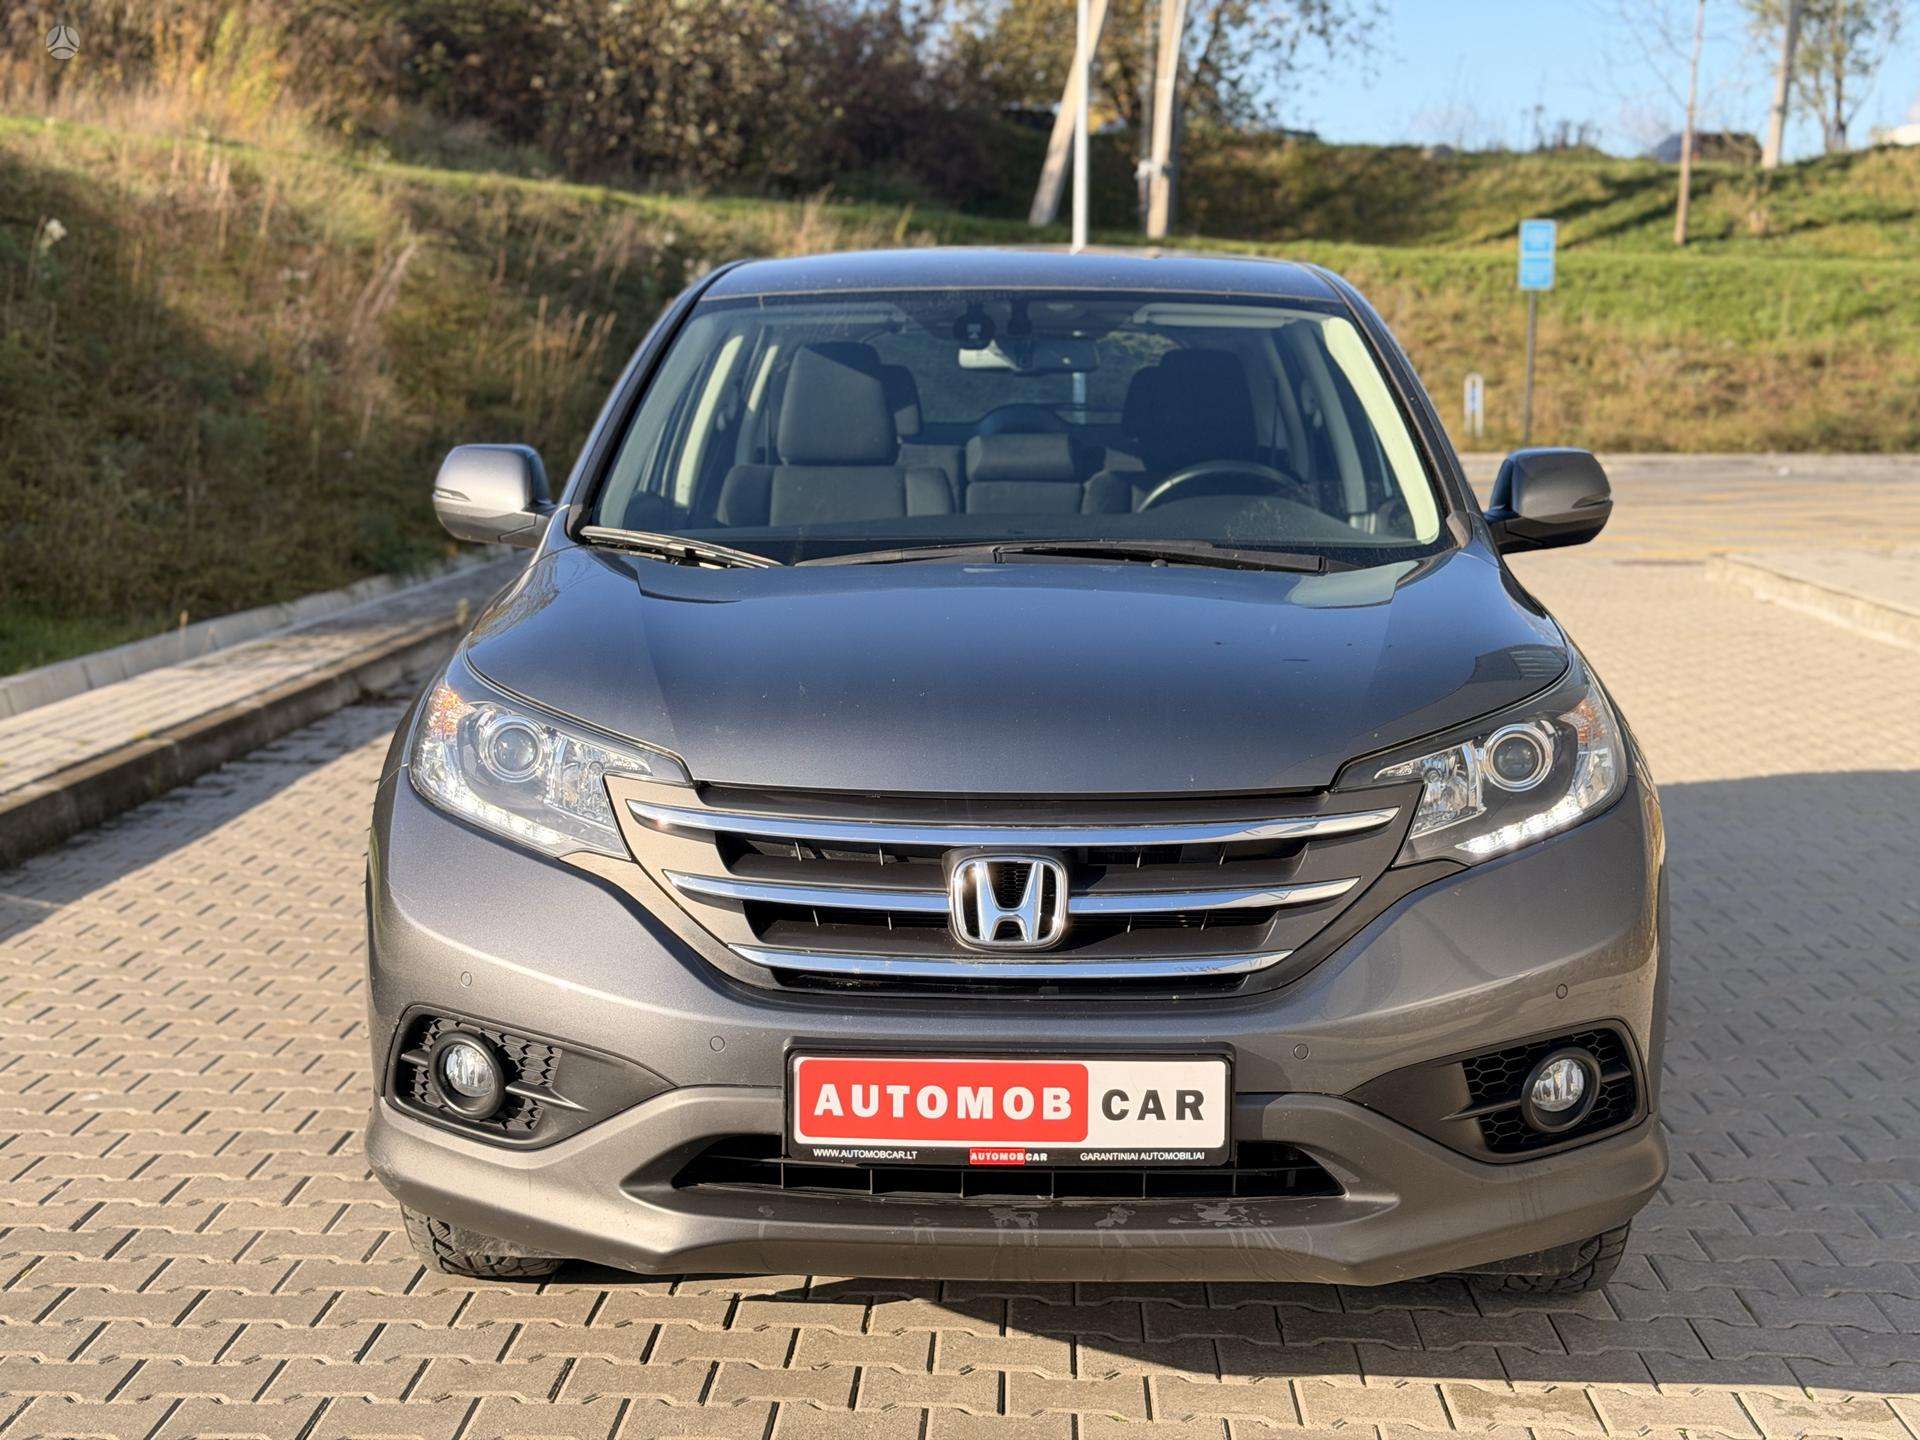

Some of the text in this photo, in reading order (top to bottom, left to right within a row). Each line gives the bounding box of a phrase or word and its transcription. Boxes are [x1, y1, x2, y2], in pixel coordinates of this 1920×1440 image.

[813, 1083, 1205, 1122] AUTOMOB CAR
[812, 1148, 918, 1160] WWW.AUTOMOBCAR.LT
[1079, 1151, 1205, 1162] GARANTINIAI AUTOMOBILIAI
